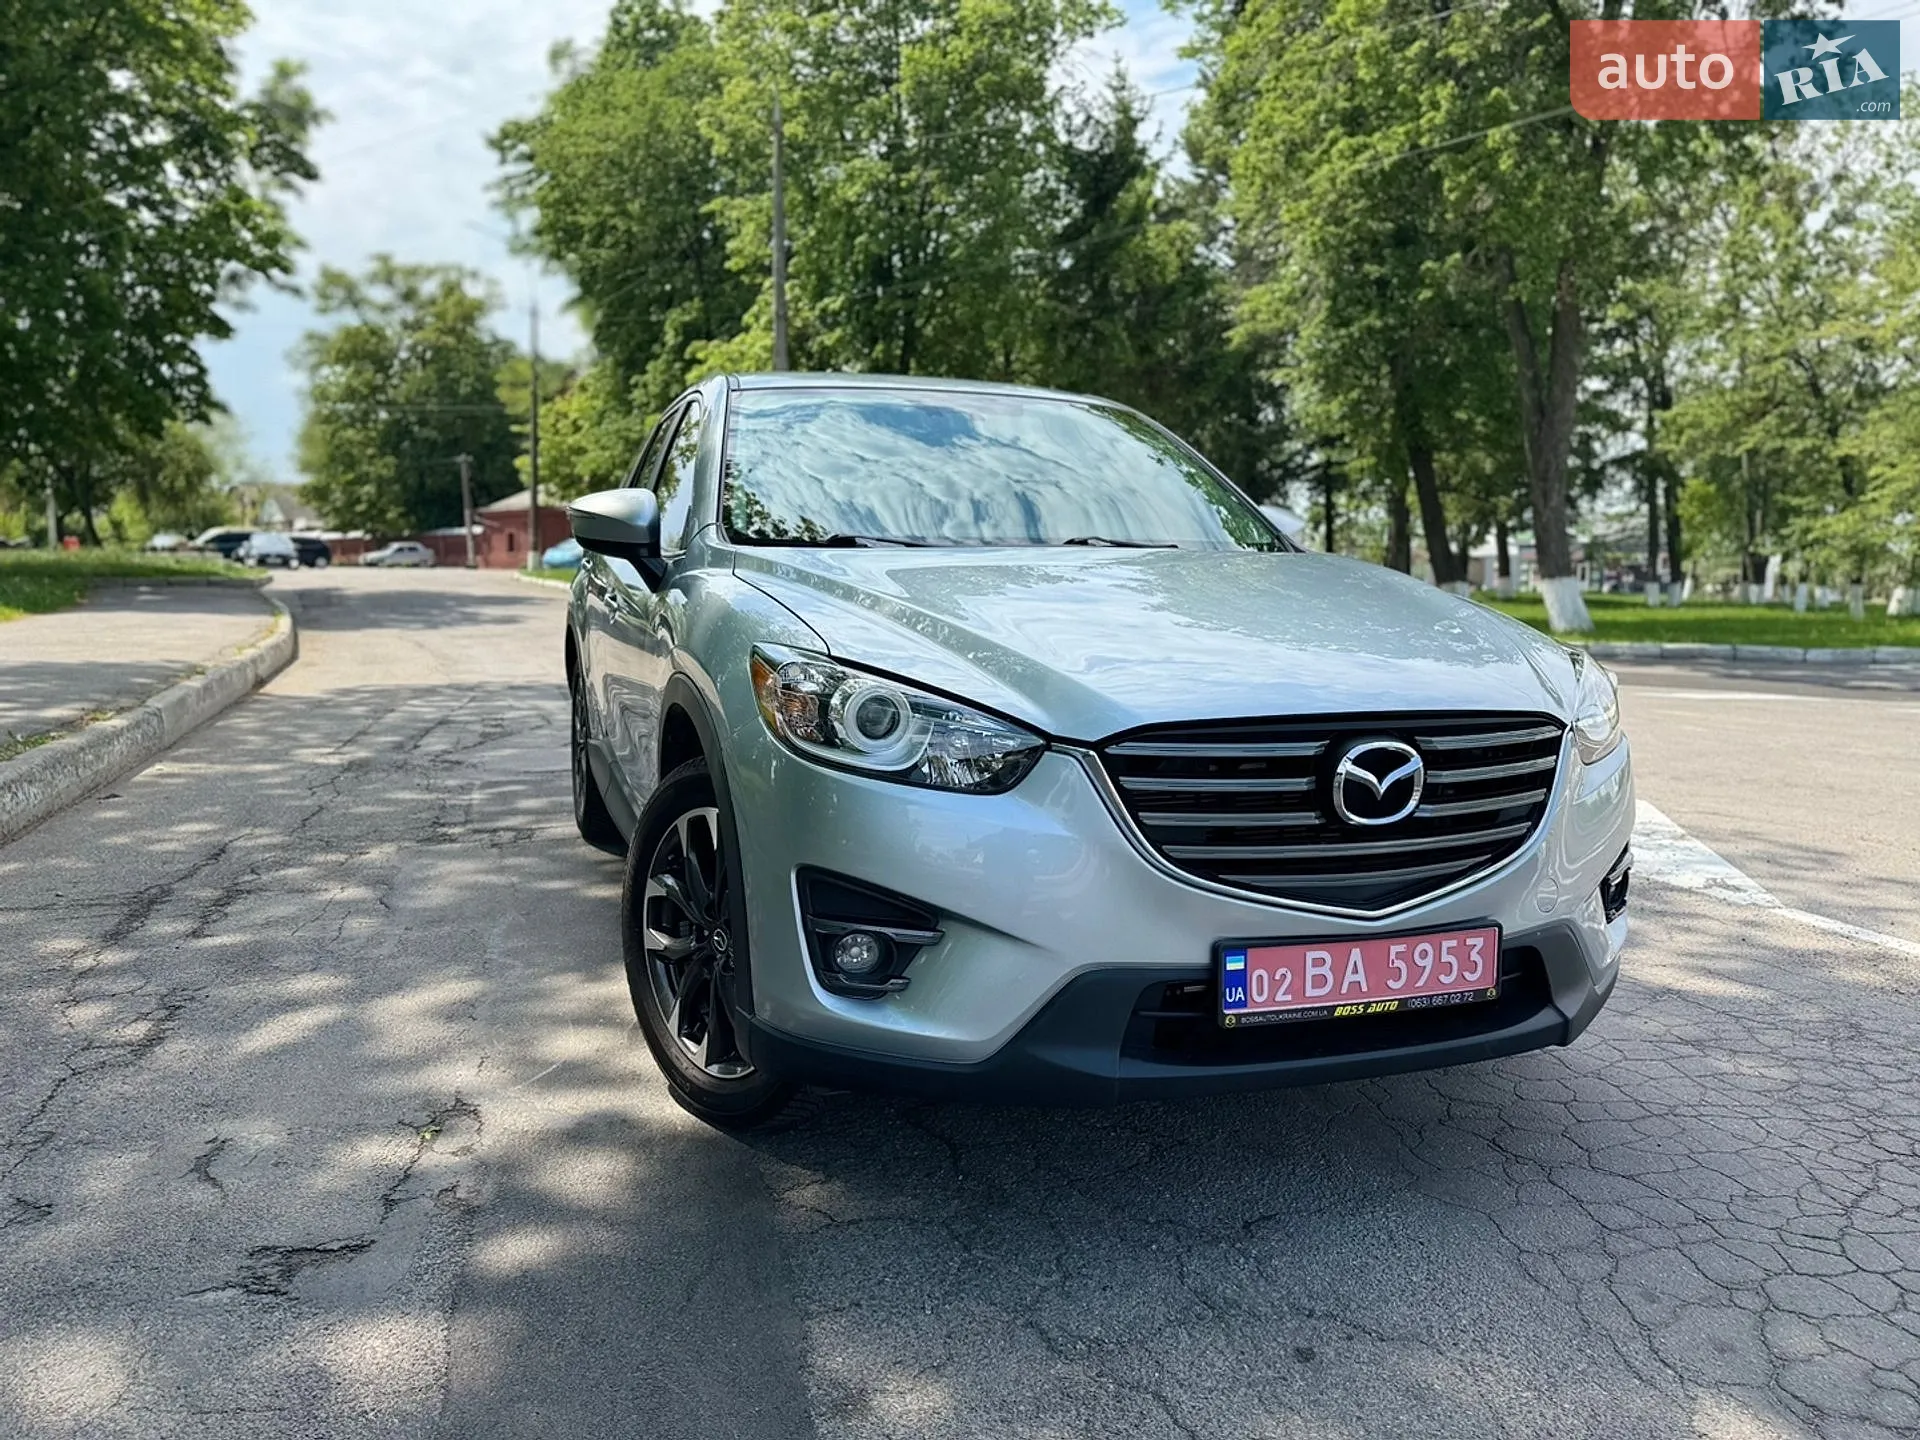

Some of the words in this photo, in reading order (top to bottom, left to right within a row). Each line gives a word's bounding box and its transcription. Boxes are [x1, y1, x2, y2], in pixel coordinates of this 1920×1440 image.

[1250, 967, 1292, 1003] 02
[1304, 948, 1367, 998] BA
[1386, 937, 1484, 990] 5953
[1226, 987, 1245, 1003] UA
[1334, 1003, 1364, 1017] BOSS
[1367, 1000, 1399, 1014] AUTO
